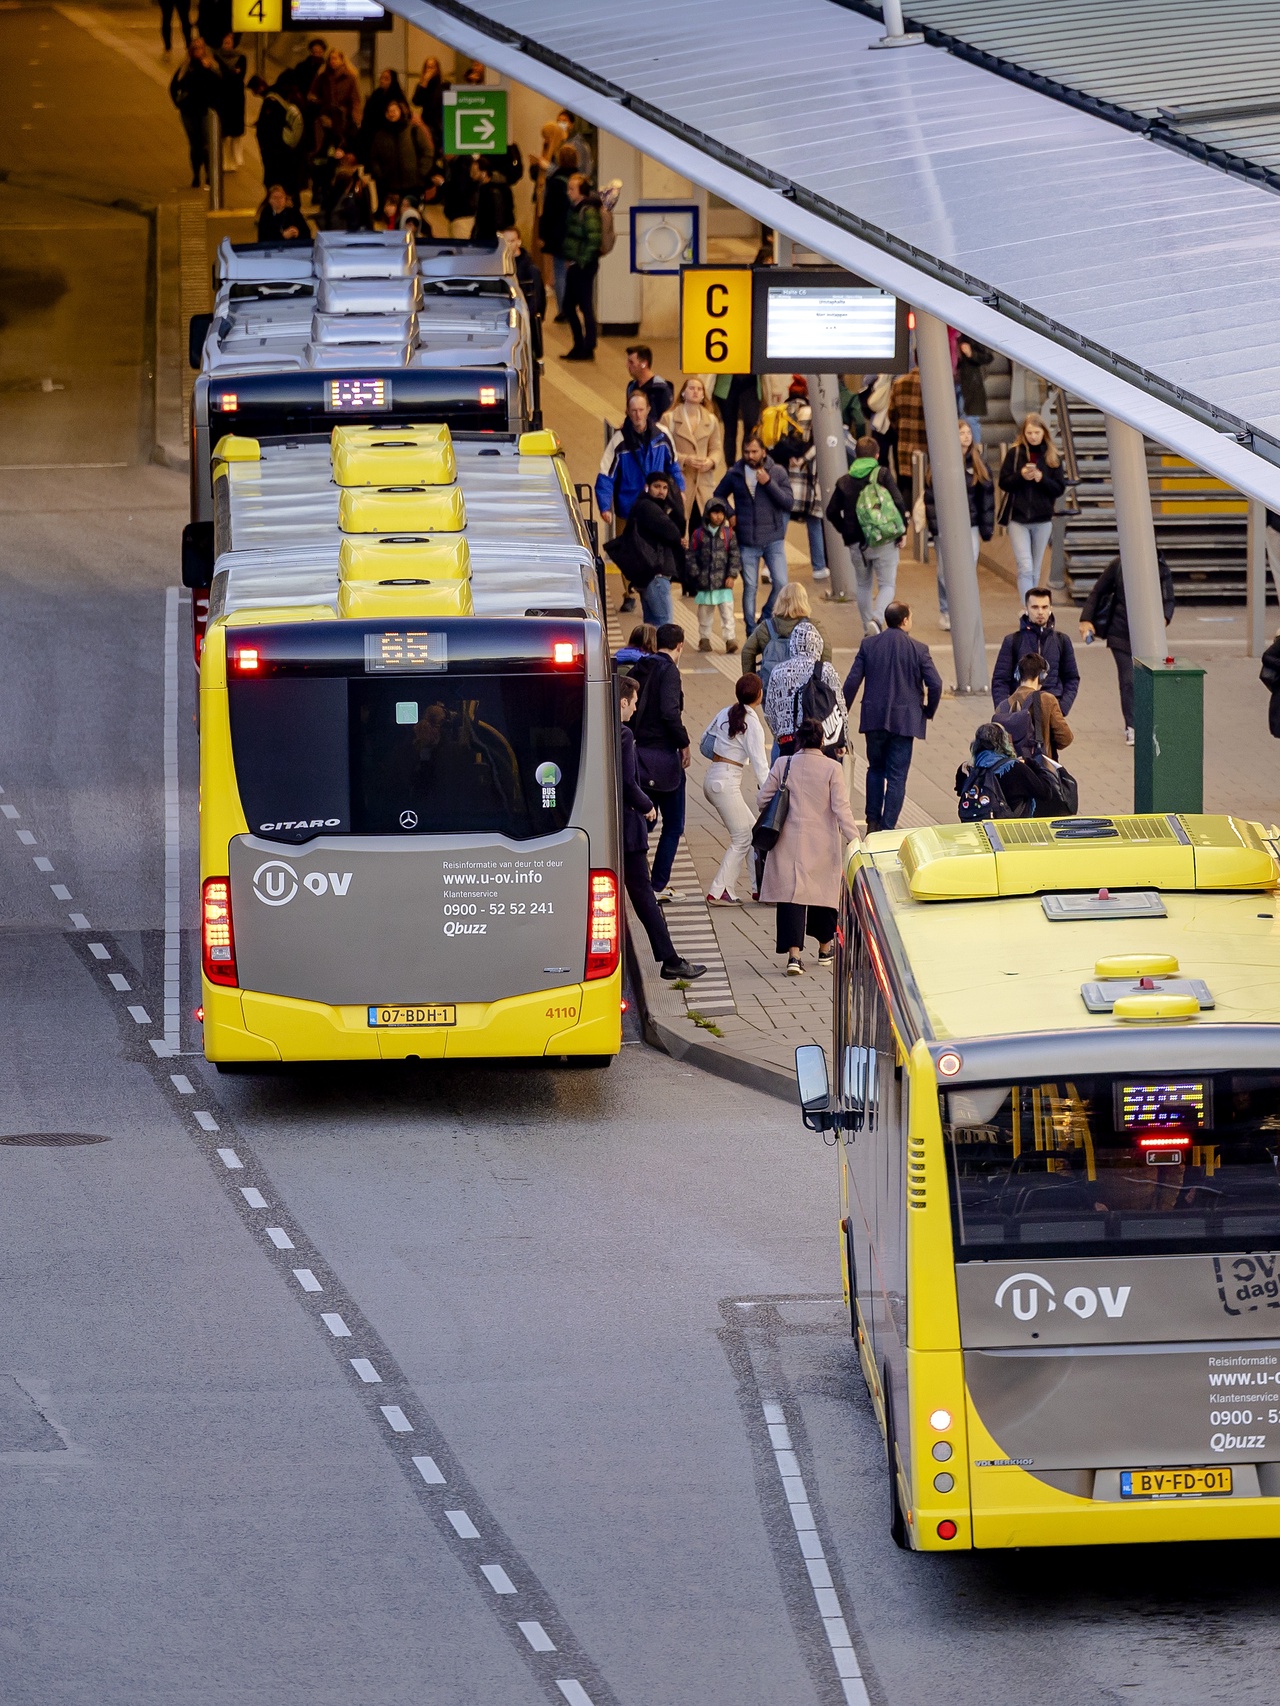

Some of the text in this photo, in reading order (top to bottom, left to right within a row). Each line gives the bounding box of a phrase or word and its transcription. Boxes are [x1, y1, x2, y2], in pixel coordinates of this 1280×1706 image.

[706, 284, 729, 318] C
[705, 328, 729, 362] 6
[260, 819, 341, 831] CITARO
[443, 861, 497, 869] Reisinformatie
[443, 870, 542, 884] www.u-ov.info
[443, 890, 498, 898] Klantenservice
[443, 904, 477, 915] 0900
[489, 904, 506, 915] 52
[509, 903, 526, 914] 52
[530, 903, 554, 914] 241
[443, 921, 487, 937] Qbuzz
[381, 1009, 447, 1023] 07-BDH-1
[545, 1006, 576, 1018] 4110
[1208, 1356, 1278, 1366] Reisinformatie
[1209, 1393, 1279, 1403] Klantenservice
[1210, 1411, 1253, 1426] 0900
[1210, 1433, 1266, 1452] Qbuzz
[1141, 1473, 1223, 1491] BV-FD-01
